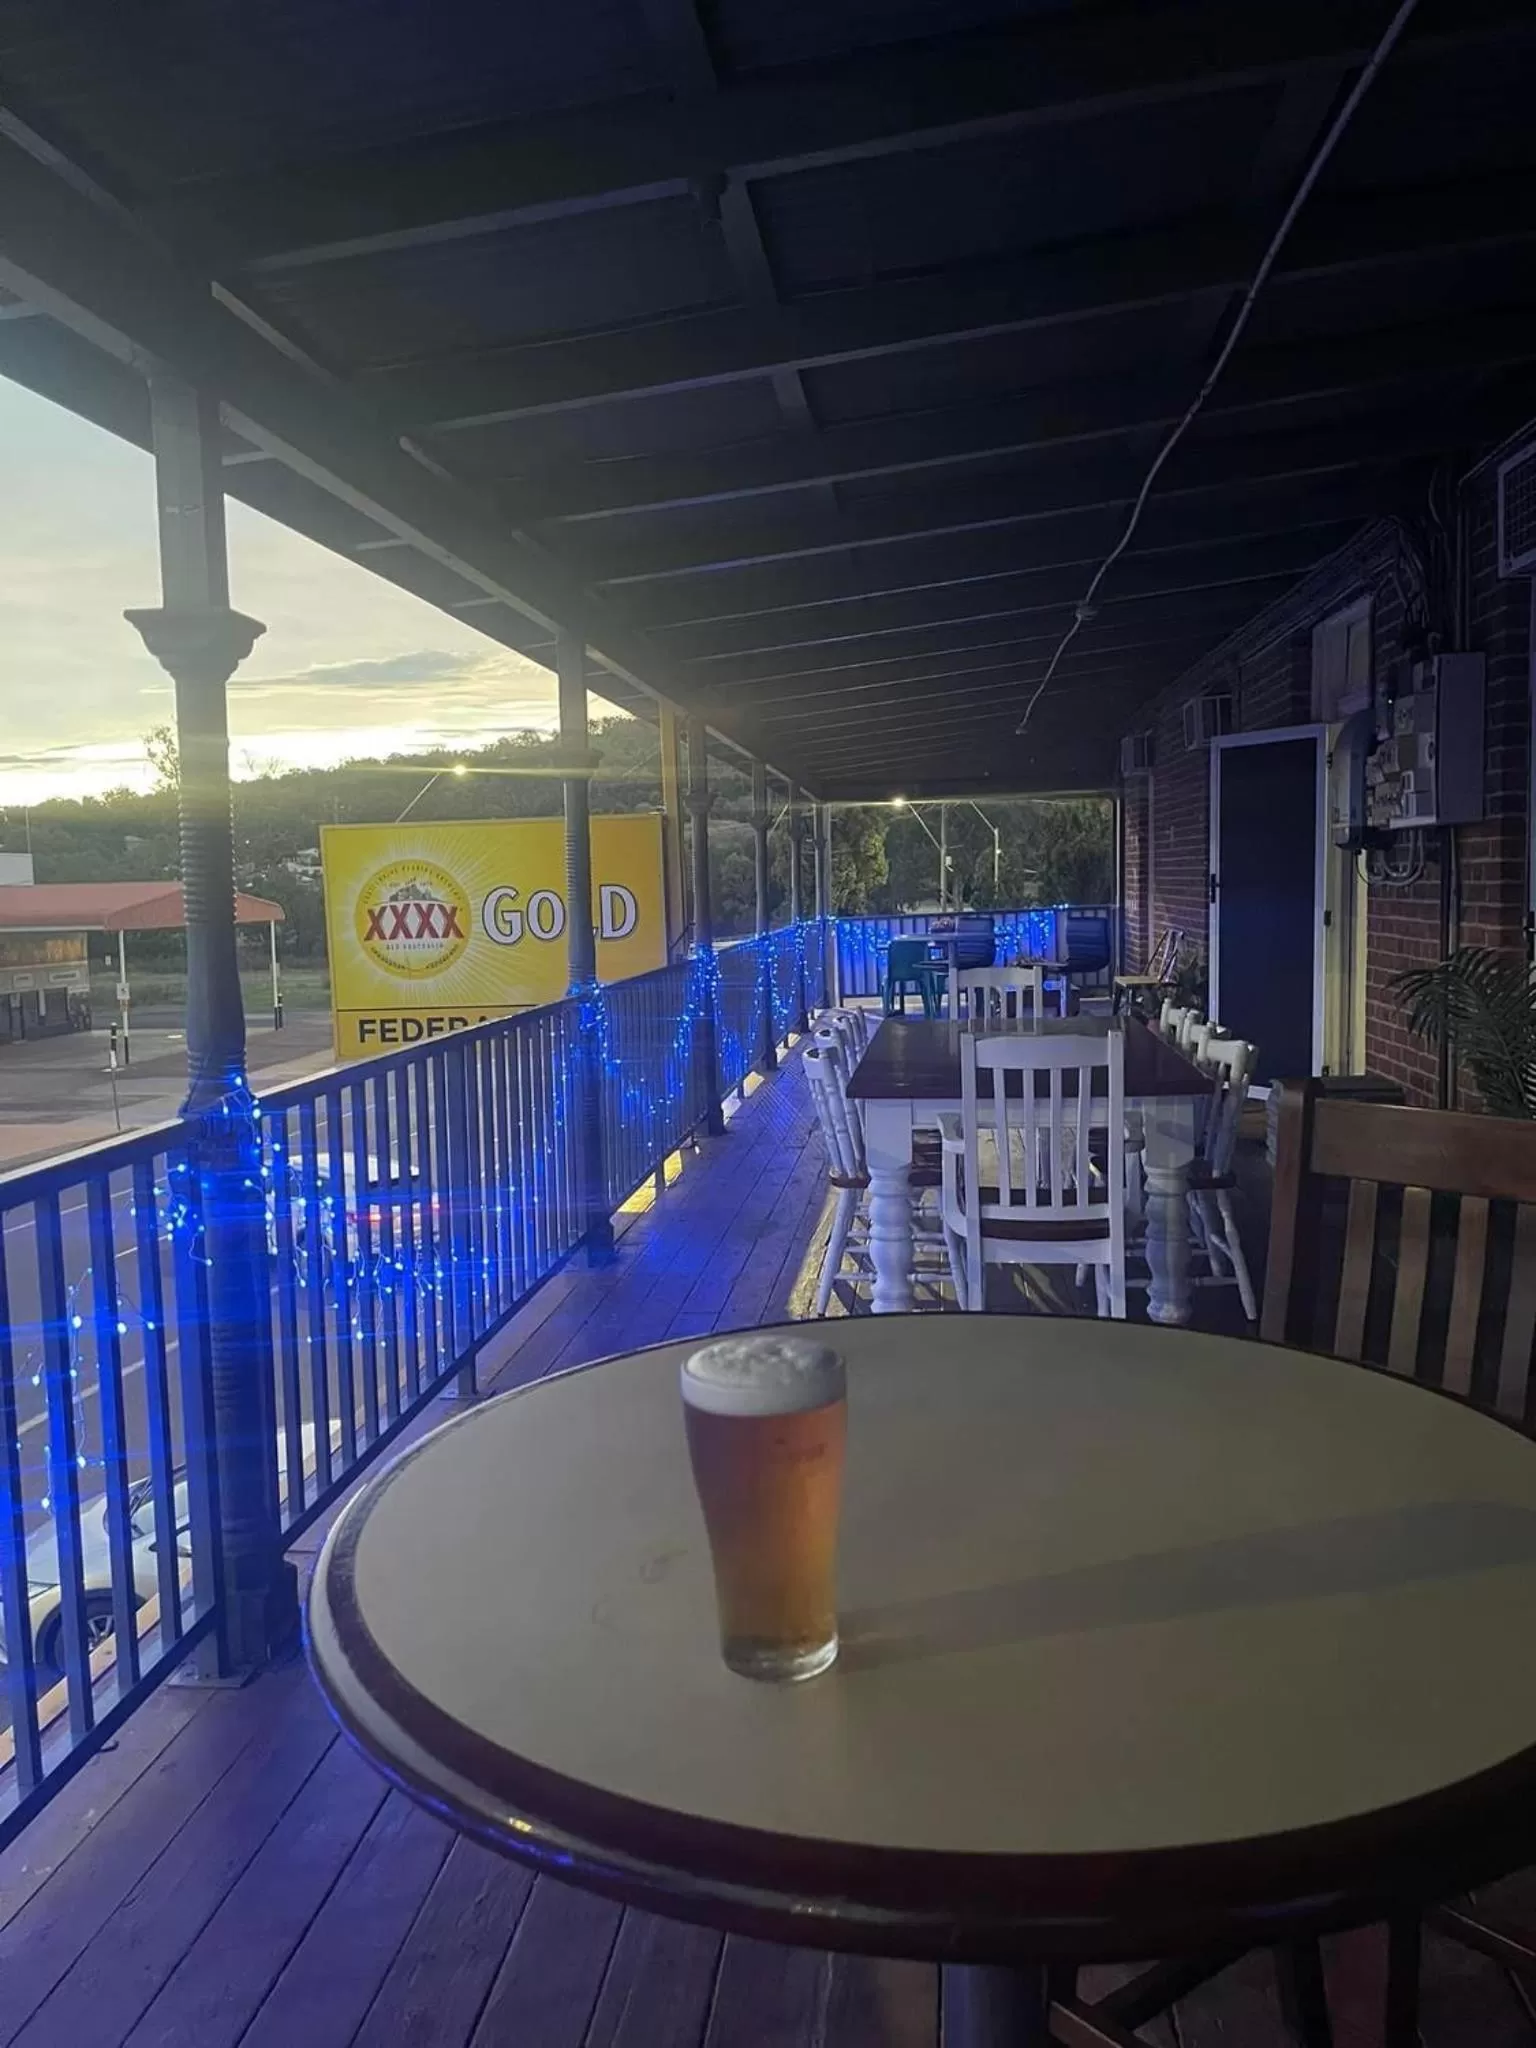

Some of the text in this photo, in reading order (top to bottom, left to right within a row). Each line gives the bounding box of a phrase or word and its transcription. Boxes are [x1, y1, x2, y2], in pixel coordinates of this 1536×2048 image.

[364, 903, 465, 941] XXXX
[482, 884, 637, 945] GOD
[358, 1015, 488, 1043] FEDER
